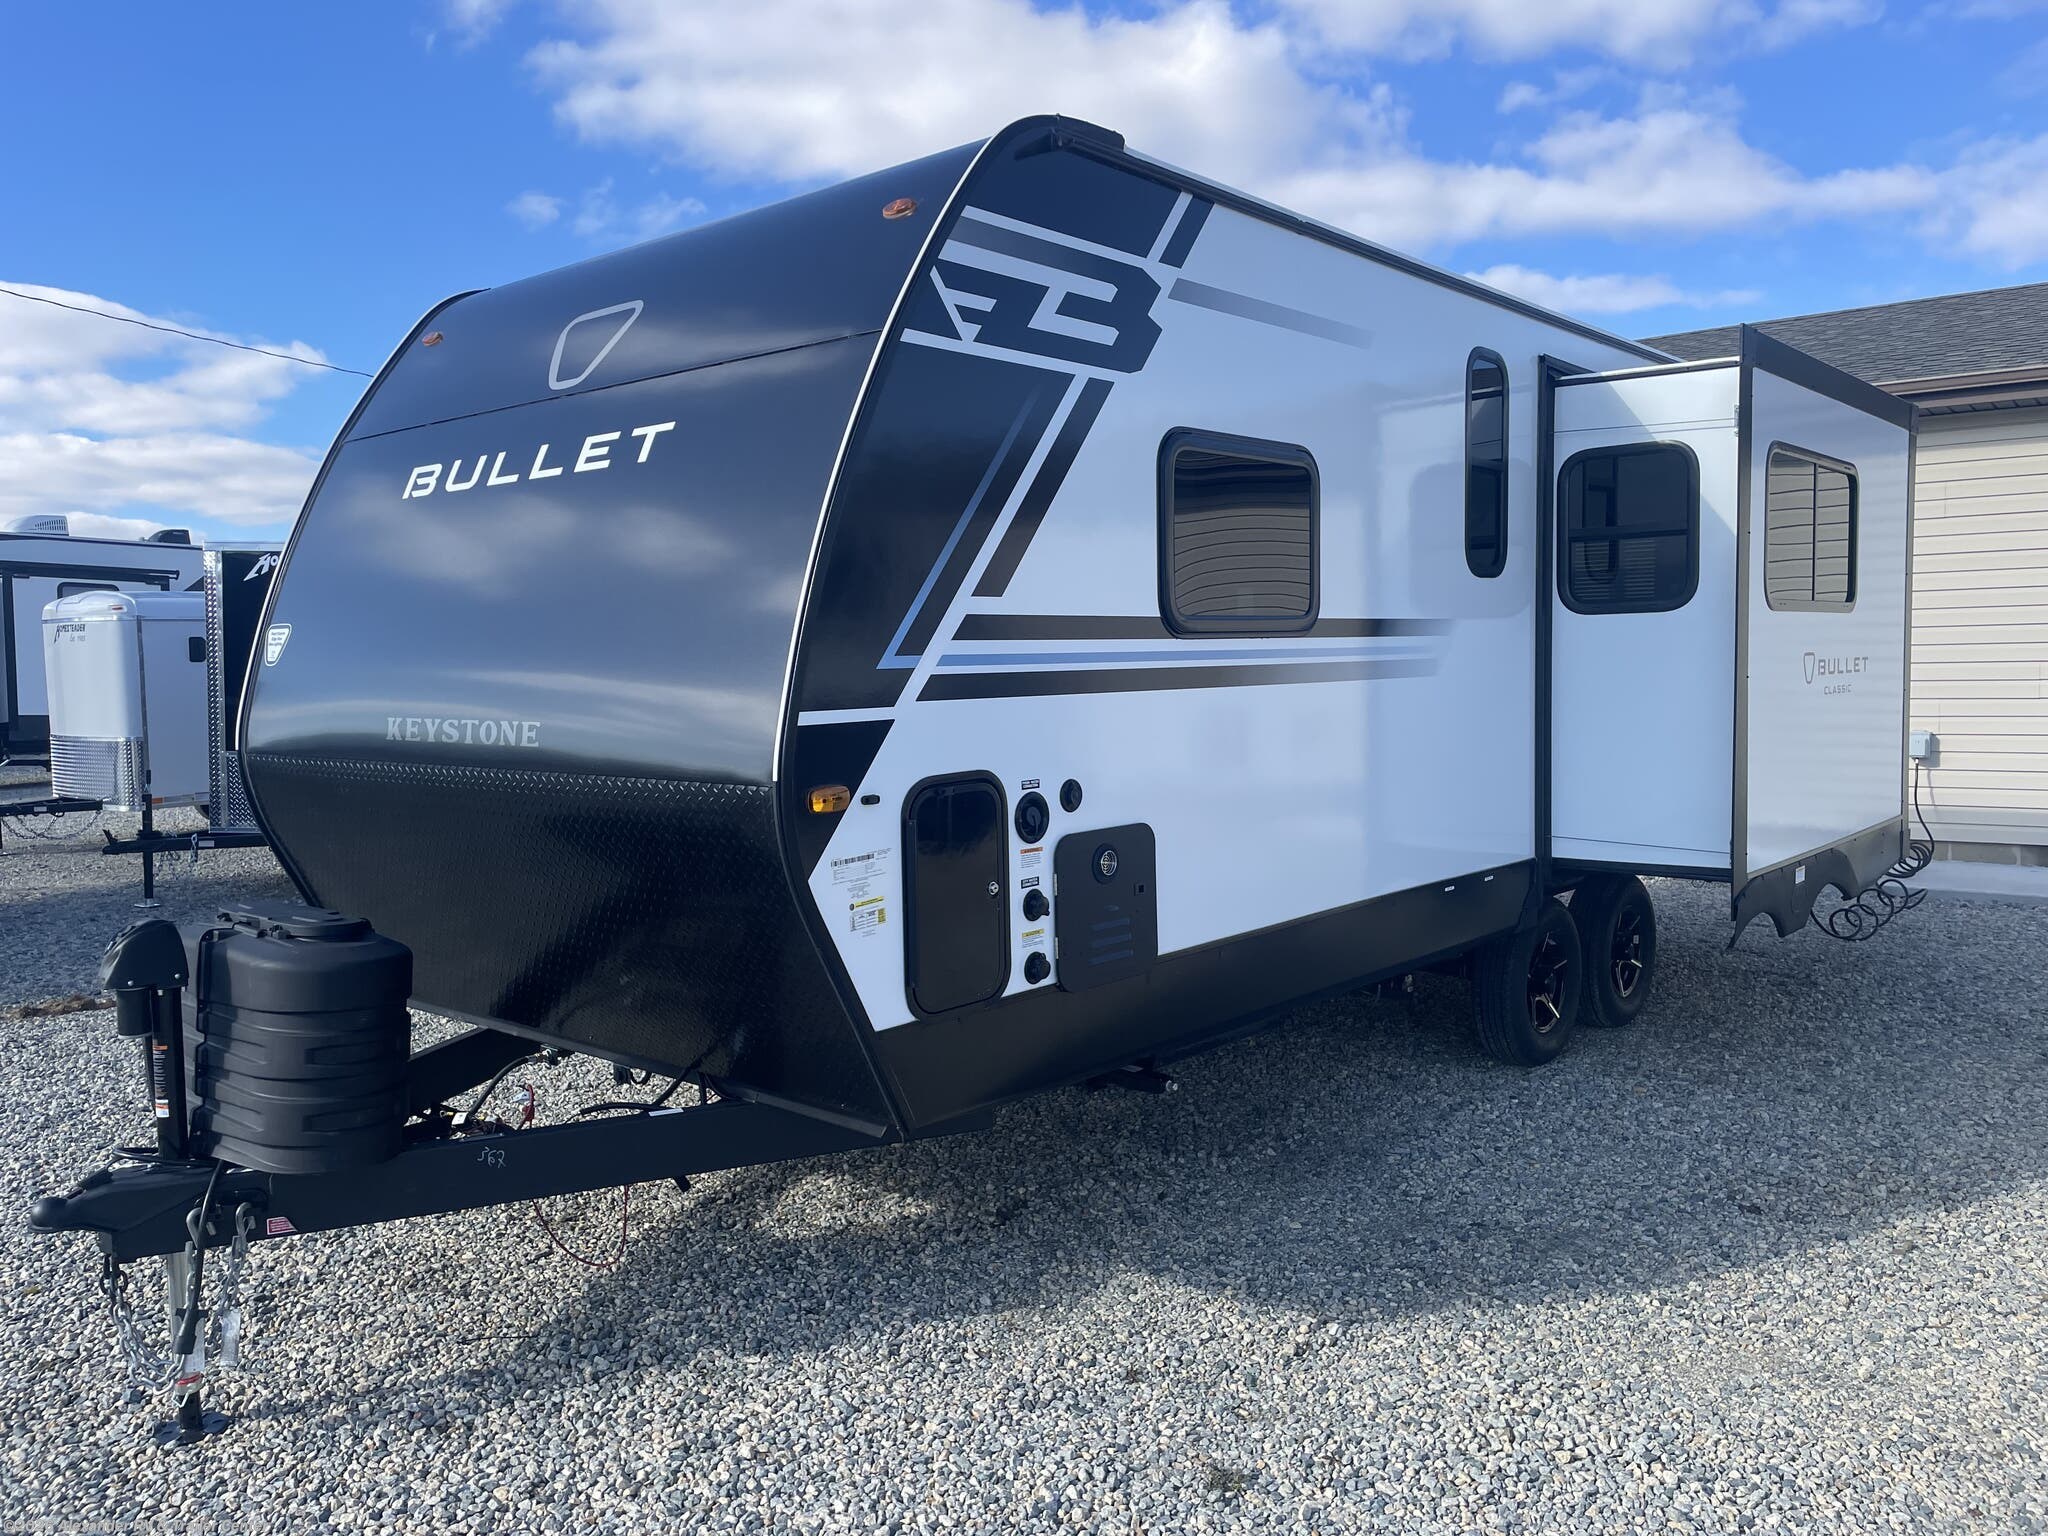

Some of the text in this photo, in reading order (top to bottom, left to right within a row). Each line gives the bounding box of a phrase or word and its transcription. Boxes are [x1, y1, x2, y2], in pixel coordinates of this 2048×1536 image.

[402, 421, 676, 499] BULLET
[1818, 656, 1869, 676] BULLET
[1823, 684, 1853, 695] CLASSIC
[385, 717, 541, 747] KEYSTONE
